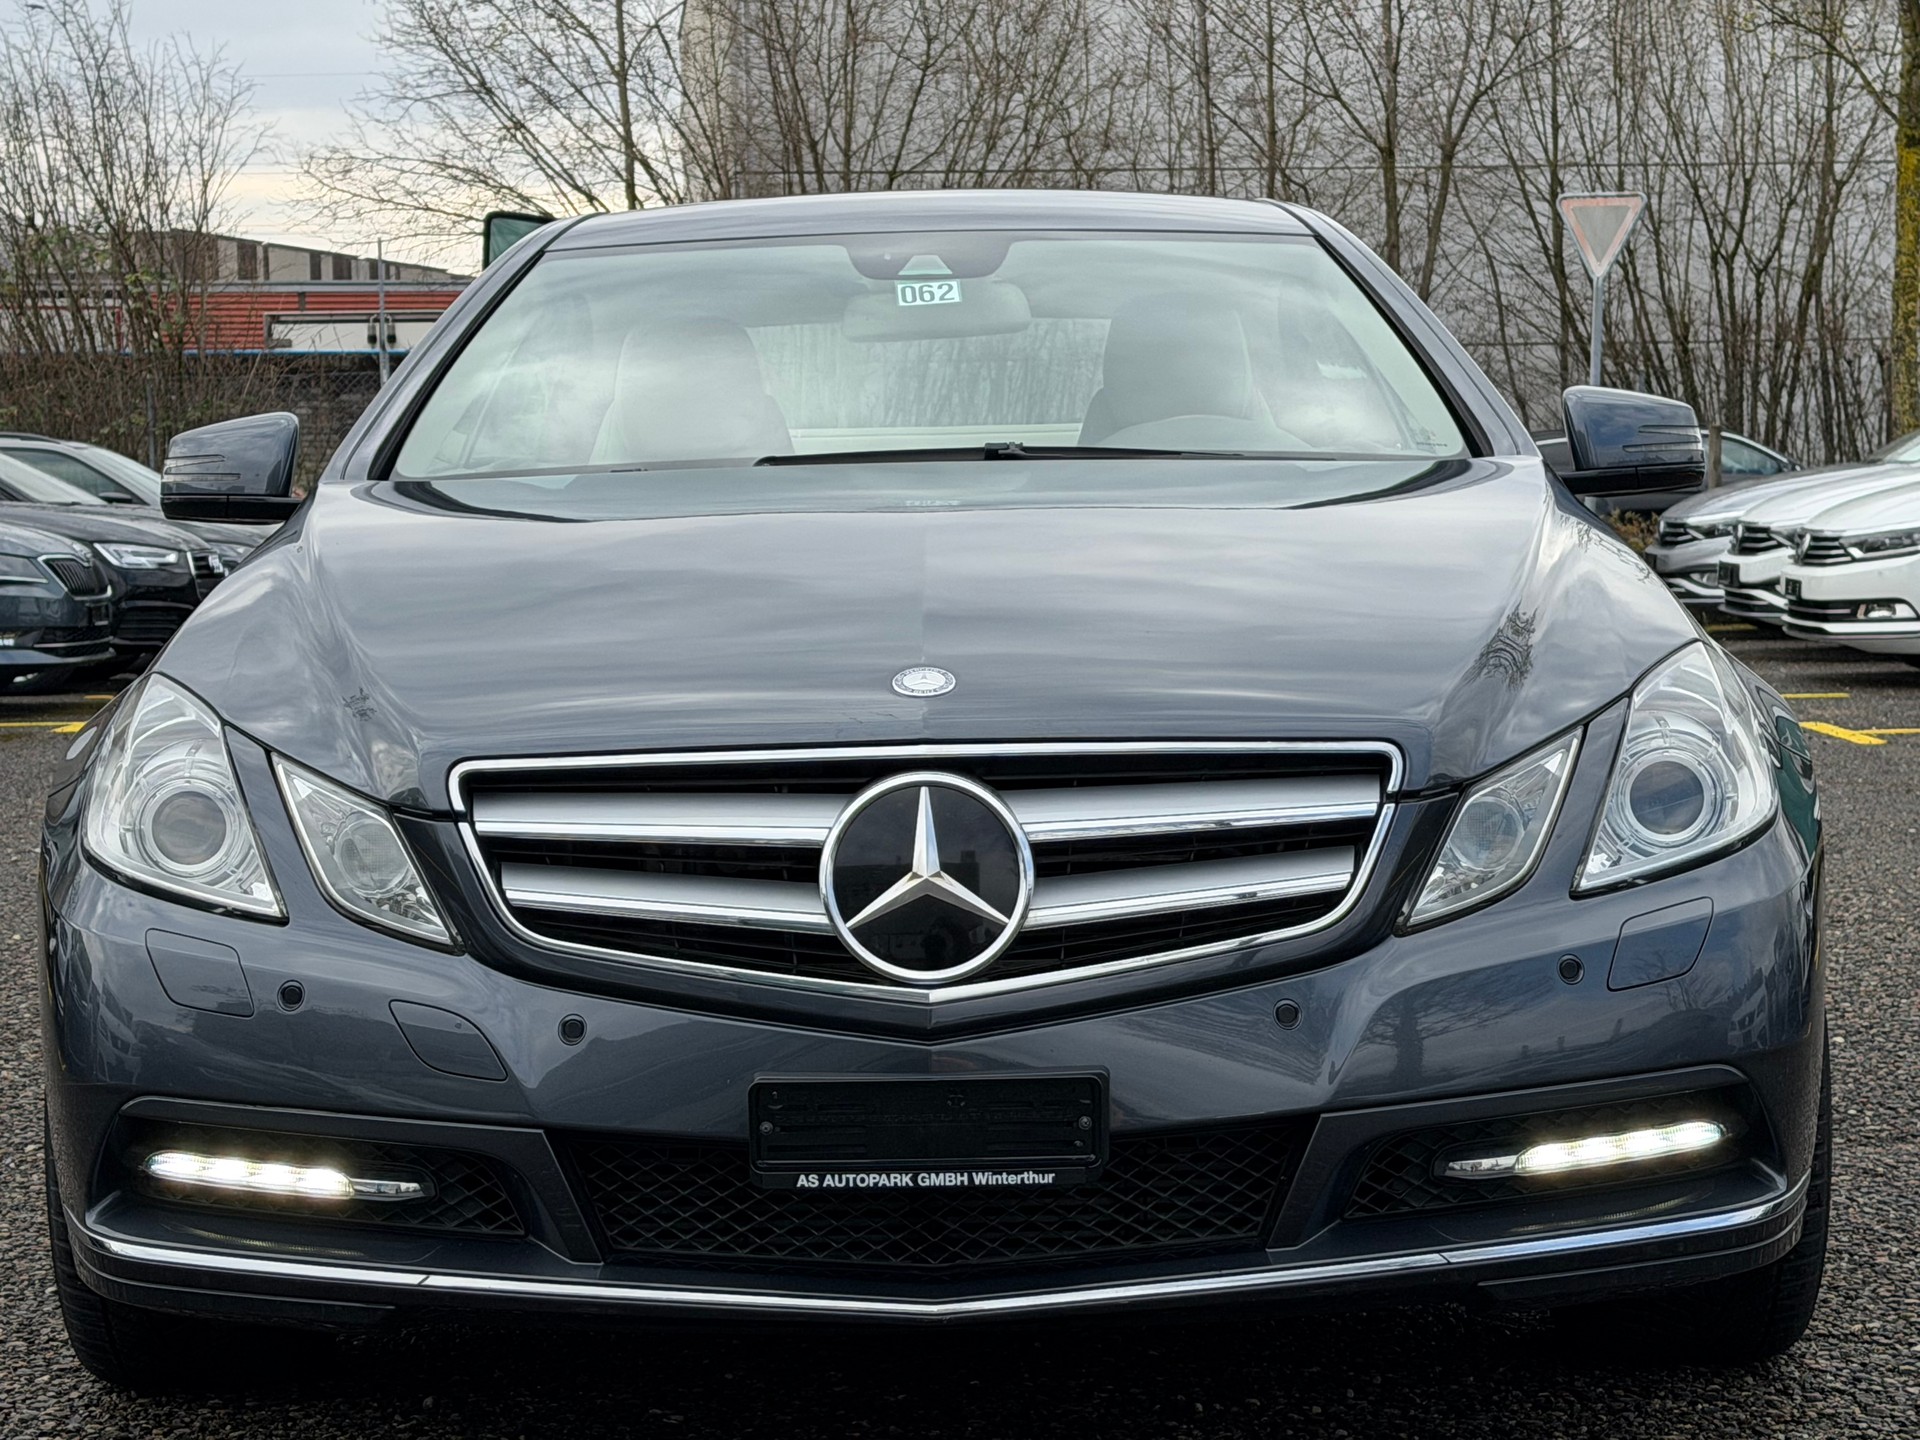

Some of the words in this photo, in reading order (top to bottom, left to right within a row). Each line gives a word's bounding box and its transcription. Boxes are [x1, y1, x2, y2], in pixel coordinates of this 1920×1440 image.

[901, 283, 955, 303] 062
[796, 1174, 820, 1188] AS
[822, 1173, 914, 1188] AUTOPARK
[917, 1172, 969, 1186] GMBH
[972, 1171, 1055, 1185] Winterthur
